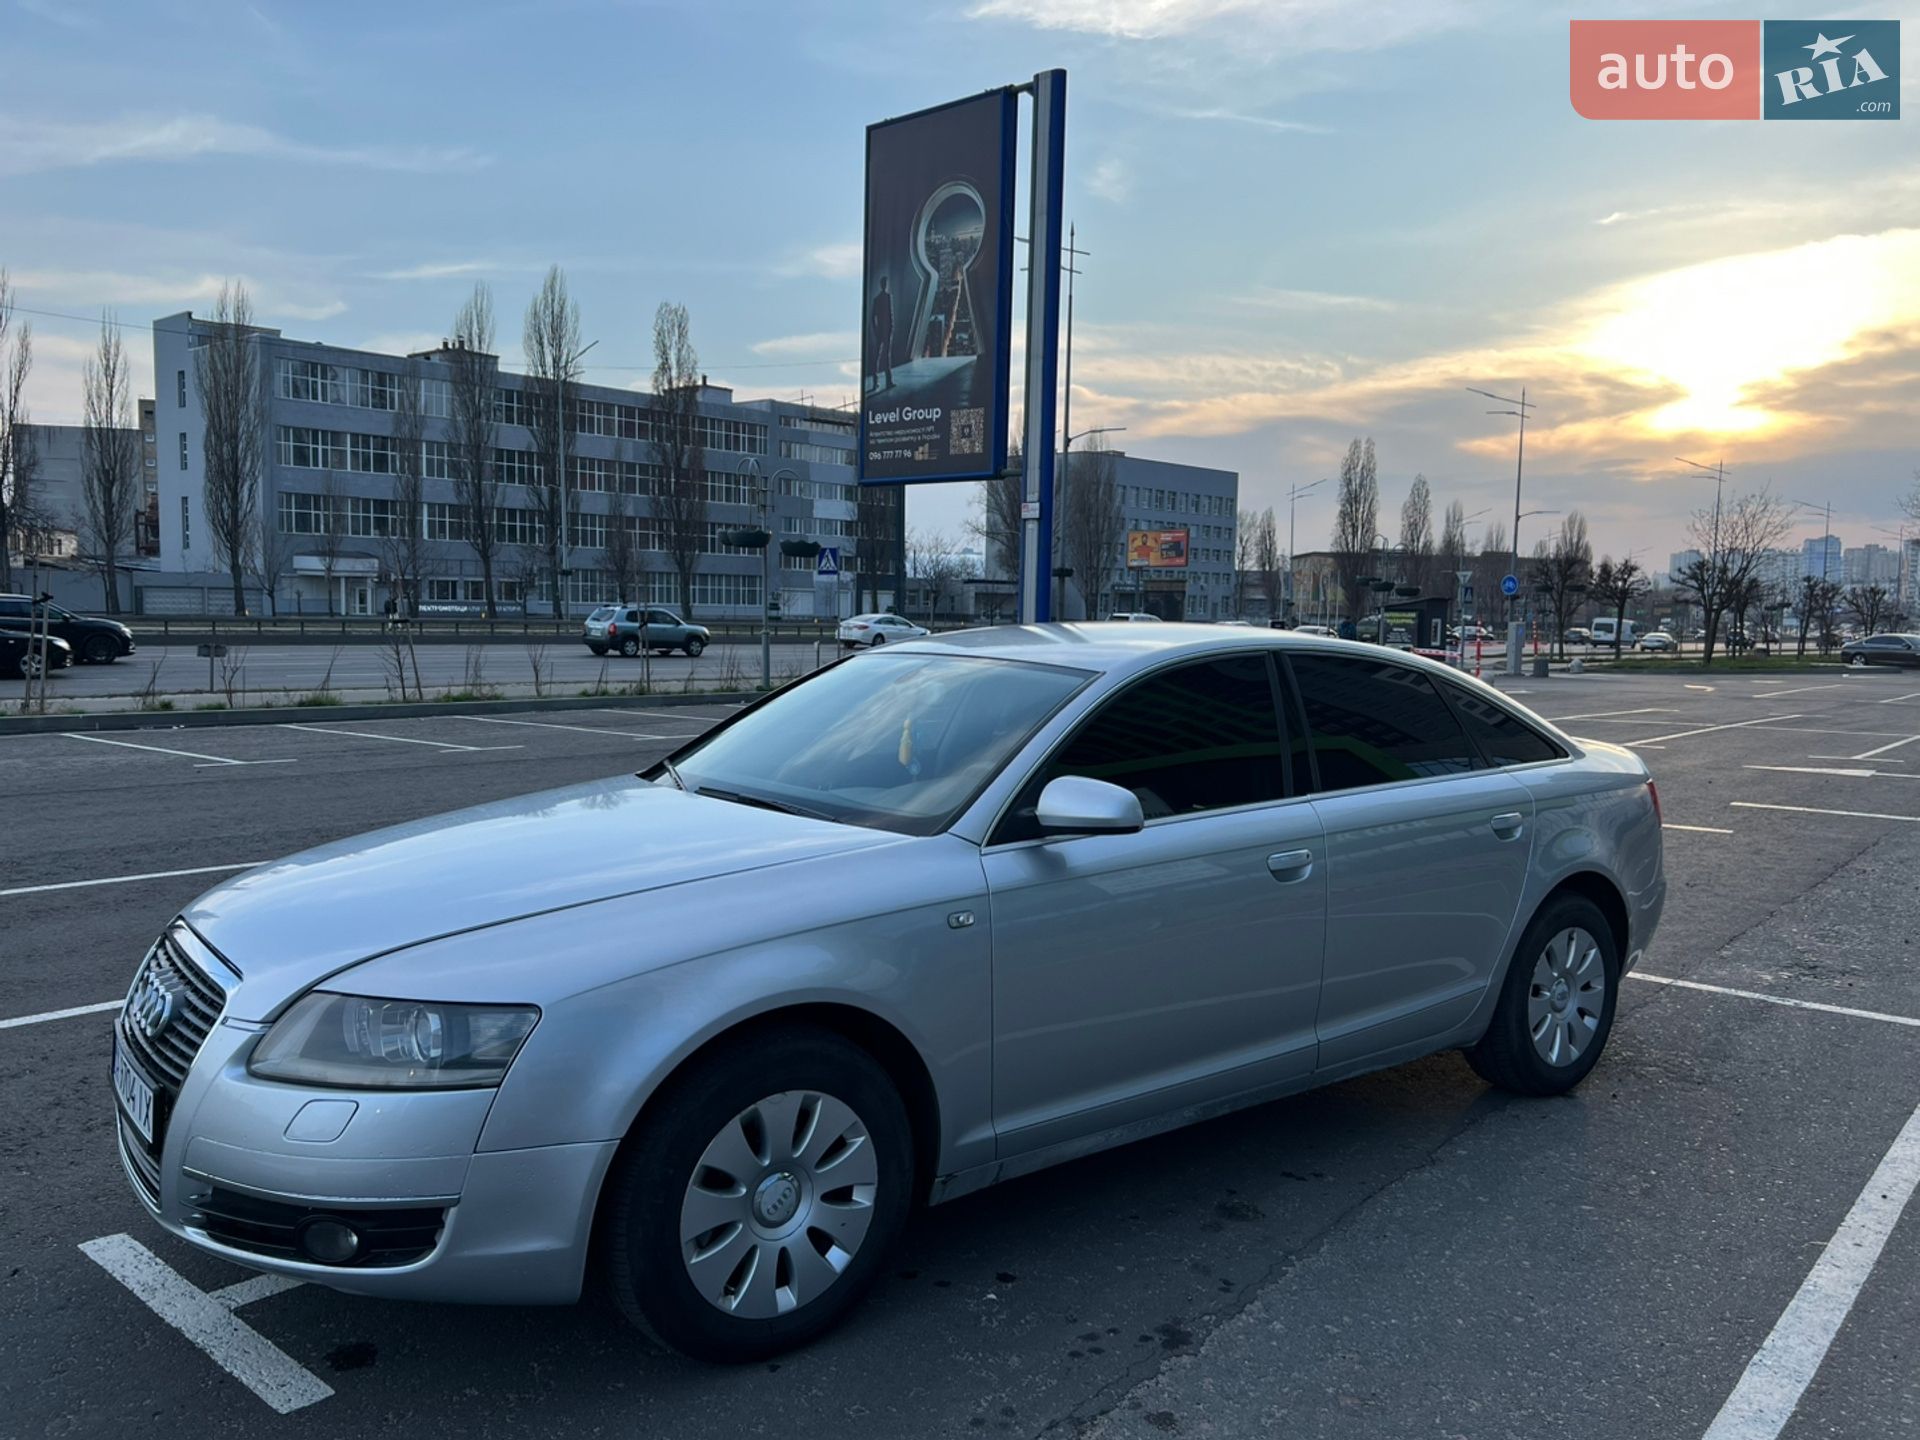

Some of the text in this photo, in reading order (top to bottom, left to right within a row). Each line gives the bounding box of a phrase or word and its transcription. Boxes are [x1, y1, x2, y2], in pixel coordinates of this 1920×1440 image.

[868, 407, 942, 424] Level Group
[869, 449, 911, 460] 096 777 77 96
